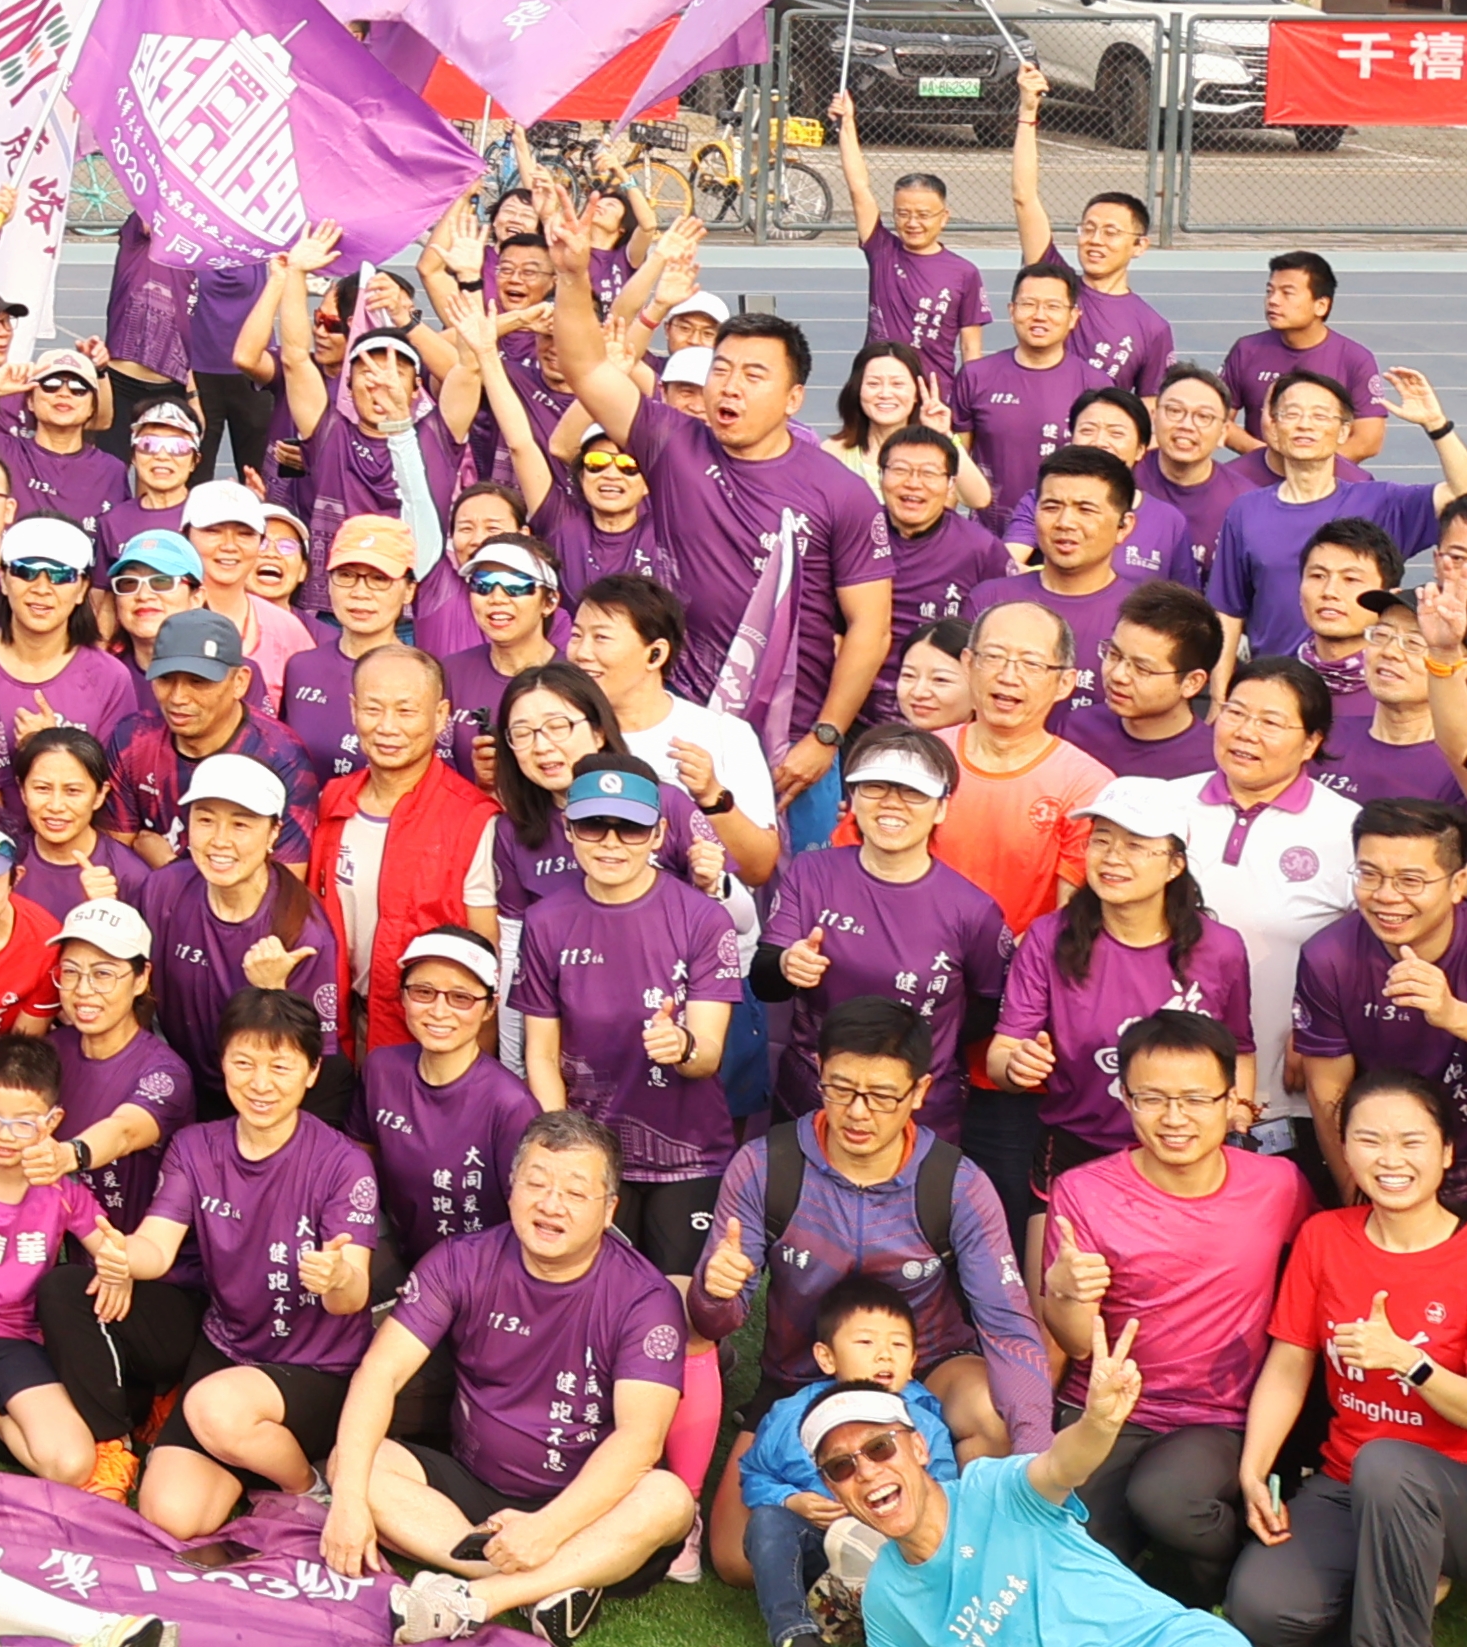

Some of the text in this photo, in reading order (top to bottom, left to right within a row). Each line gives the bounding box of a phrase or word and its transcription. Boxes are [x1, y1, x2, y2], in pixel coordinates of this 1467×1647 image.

[1338, 31, 1466, 80] 千禧
[991, 392, 1020, 405] 113th
[28, 478, 57, 493] 113th
[296, 685, 327, 704] 113th
[536, 859, 578, 876] 113th
[74, 909, 121, 927] SJTU
[819, 911, 864, 935] 113th
[560, 948, 604, 964] 113th
[1364, 1004, 1409, 1021] 113th
[376, 1110, 412, 1133] 113th
[201, 1196, 241, 1219] 113th
[268, 1244, 290, 1337] 健跑不息
[488, 1314, 530, 1337] 113th
